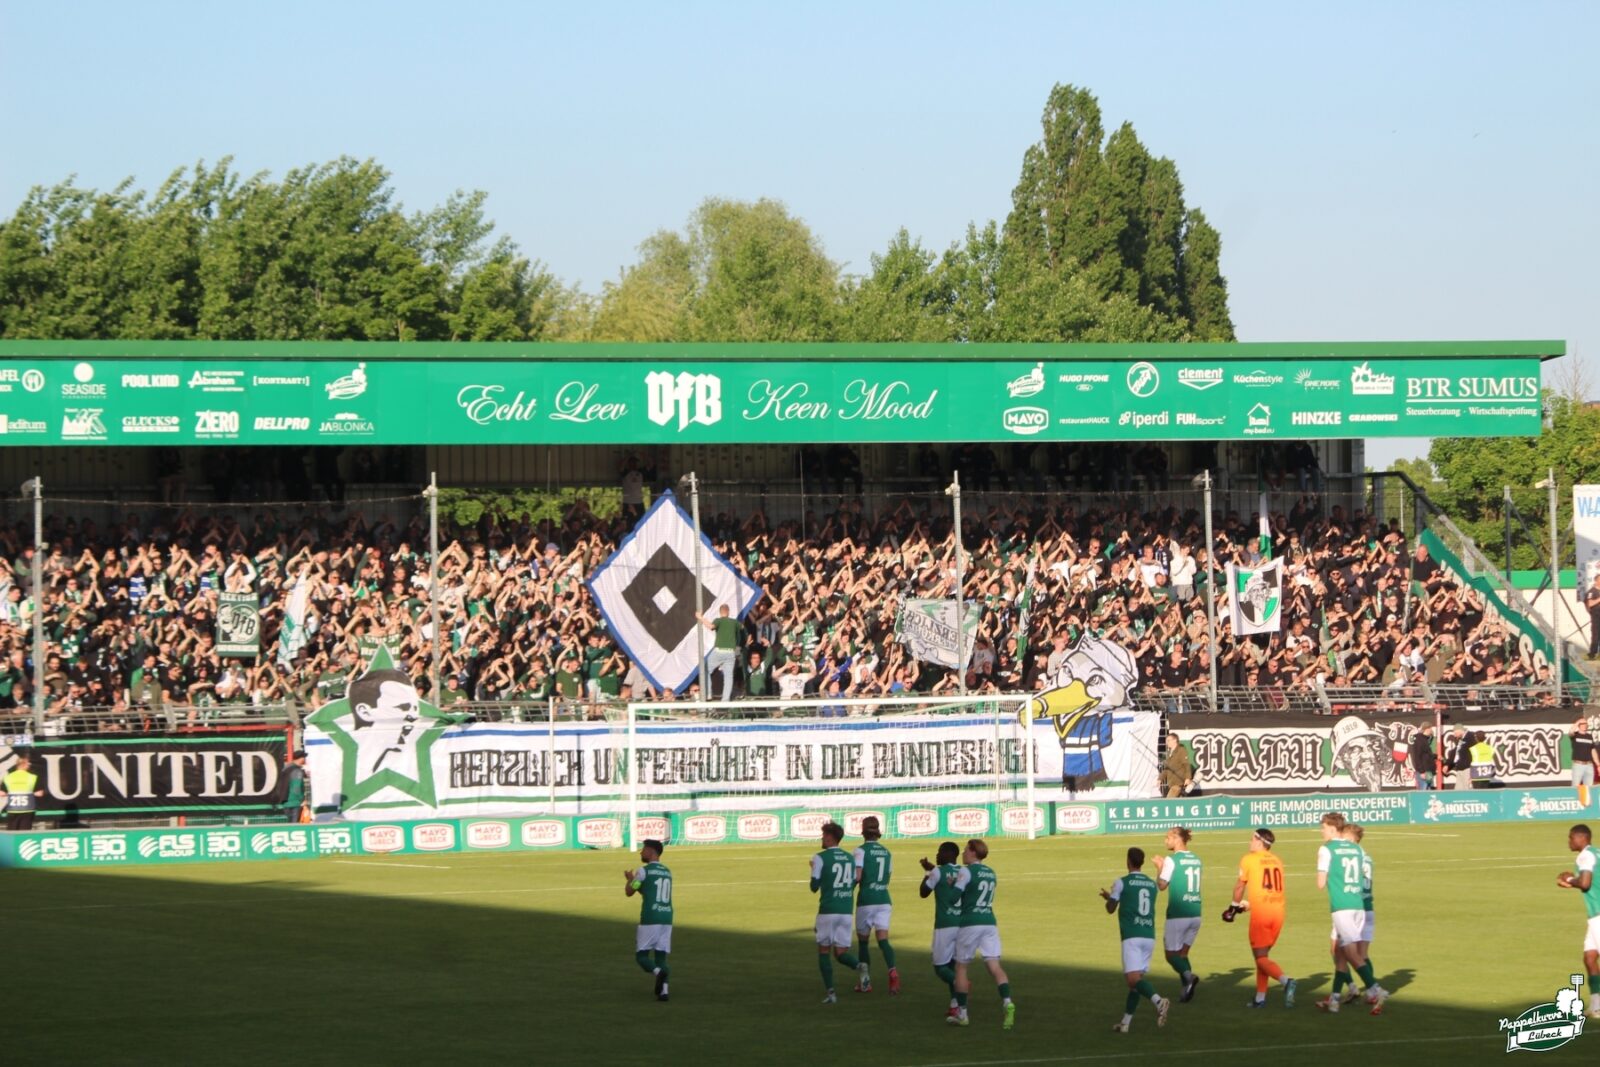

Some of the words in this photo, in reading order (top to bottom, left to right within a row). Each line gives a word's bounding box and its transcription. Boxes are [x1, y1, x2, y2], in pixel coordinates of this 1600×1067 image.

[1178, 368, 1223, 378] clement
[61, 384, 107, 395] SEASIDE
[1406, 378, 1452, 397] BTR
[1458, 377, 1538, 397] SUMUS
[457, 384, 537, 425] Echt
[548, 381, 629, 423] Leev
[742, 379, 831, 421] Keen
[838, 379, 938, 421] Mood
[1007, 413, 1044, 425] MAYO
[1292, 411, 1342, 425] HINZKE
[1406, 407, 1460, 417] Steuerberatung
[1469, 406, 1537, 417] Wirtschaftsprüfung
[253, 417, 310, 430] DELLPRO
[319, 422, 375, 432] JABLONKA
[1132, 411, 1169, 428] iperdi
[449, 749, 586, 788] HERZLICH
[785, 744, 813, 780] IN
[821, 743, 864, 780] DIE
[41, 751, 278, 800] UNITED
[9, 796, 28, 806] 215
[1250, 801, 1276, 812] IHRE
[1279, 797, 1407, 812] IMMOBILIENEXPERTEN
[1445, 803, 1489, 814] HOLSTEN
[904, 813, 931, 822] MAYO
[955, 812, 982, 820] MAYO
[1108, 804, 1241, 819] KENSINGTON
[1250, 814, 1263, 825] IN
[1265, 813, 1289, 825] DER
[1352, 809, 1393, 822] BUCHT.
[529, 824, 557, 832] MAYO
[585, 822, 612, 831] MAYO
[637, 822, 664, 830] MAYO
[692, 819, 719, 828] MAYO
[744, 818, 772, 826] MAYO
[369, 830, 396, 838] MAYO
[475, 826, 502, 834] MAYO
[41, 837, 79, 853] FLS
[159, 834, 195, 848] FLS
[207, 836, 240, 852] 30
[271, 831, 307, 846] FLS
[318, 832, 351, 848] 30
[91, 839, 126, 855] 30
[832, 862, 853, 888] 24
[1341, 856, 1359, 883] 21
[1184, 866, 1200, 892] 11
[1262, 868, 1282, 893] 40
[654, 878, 671, 903] 10
[1138, 888, 1150, 916] 6
